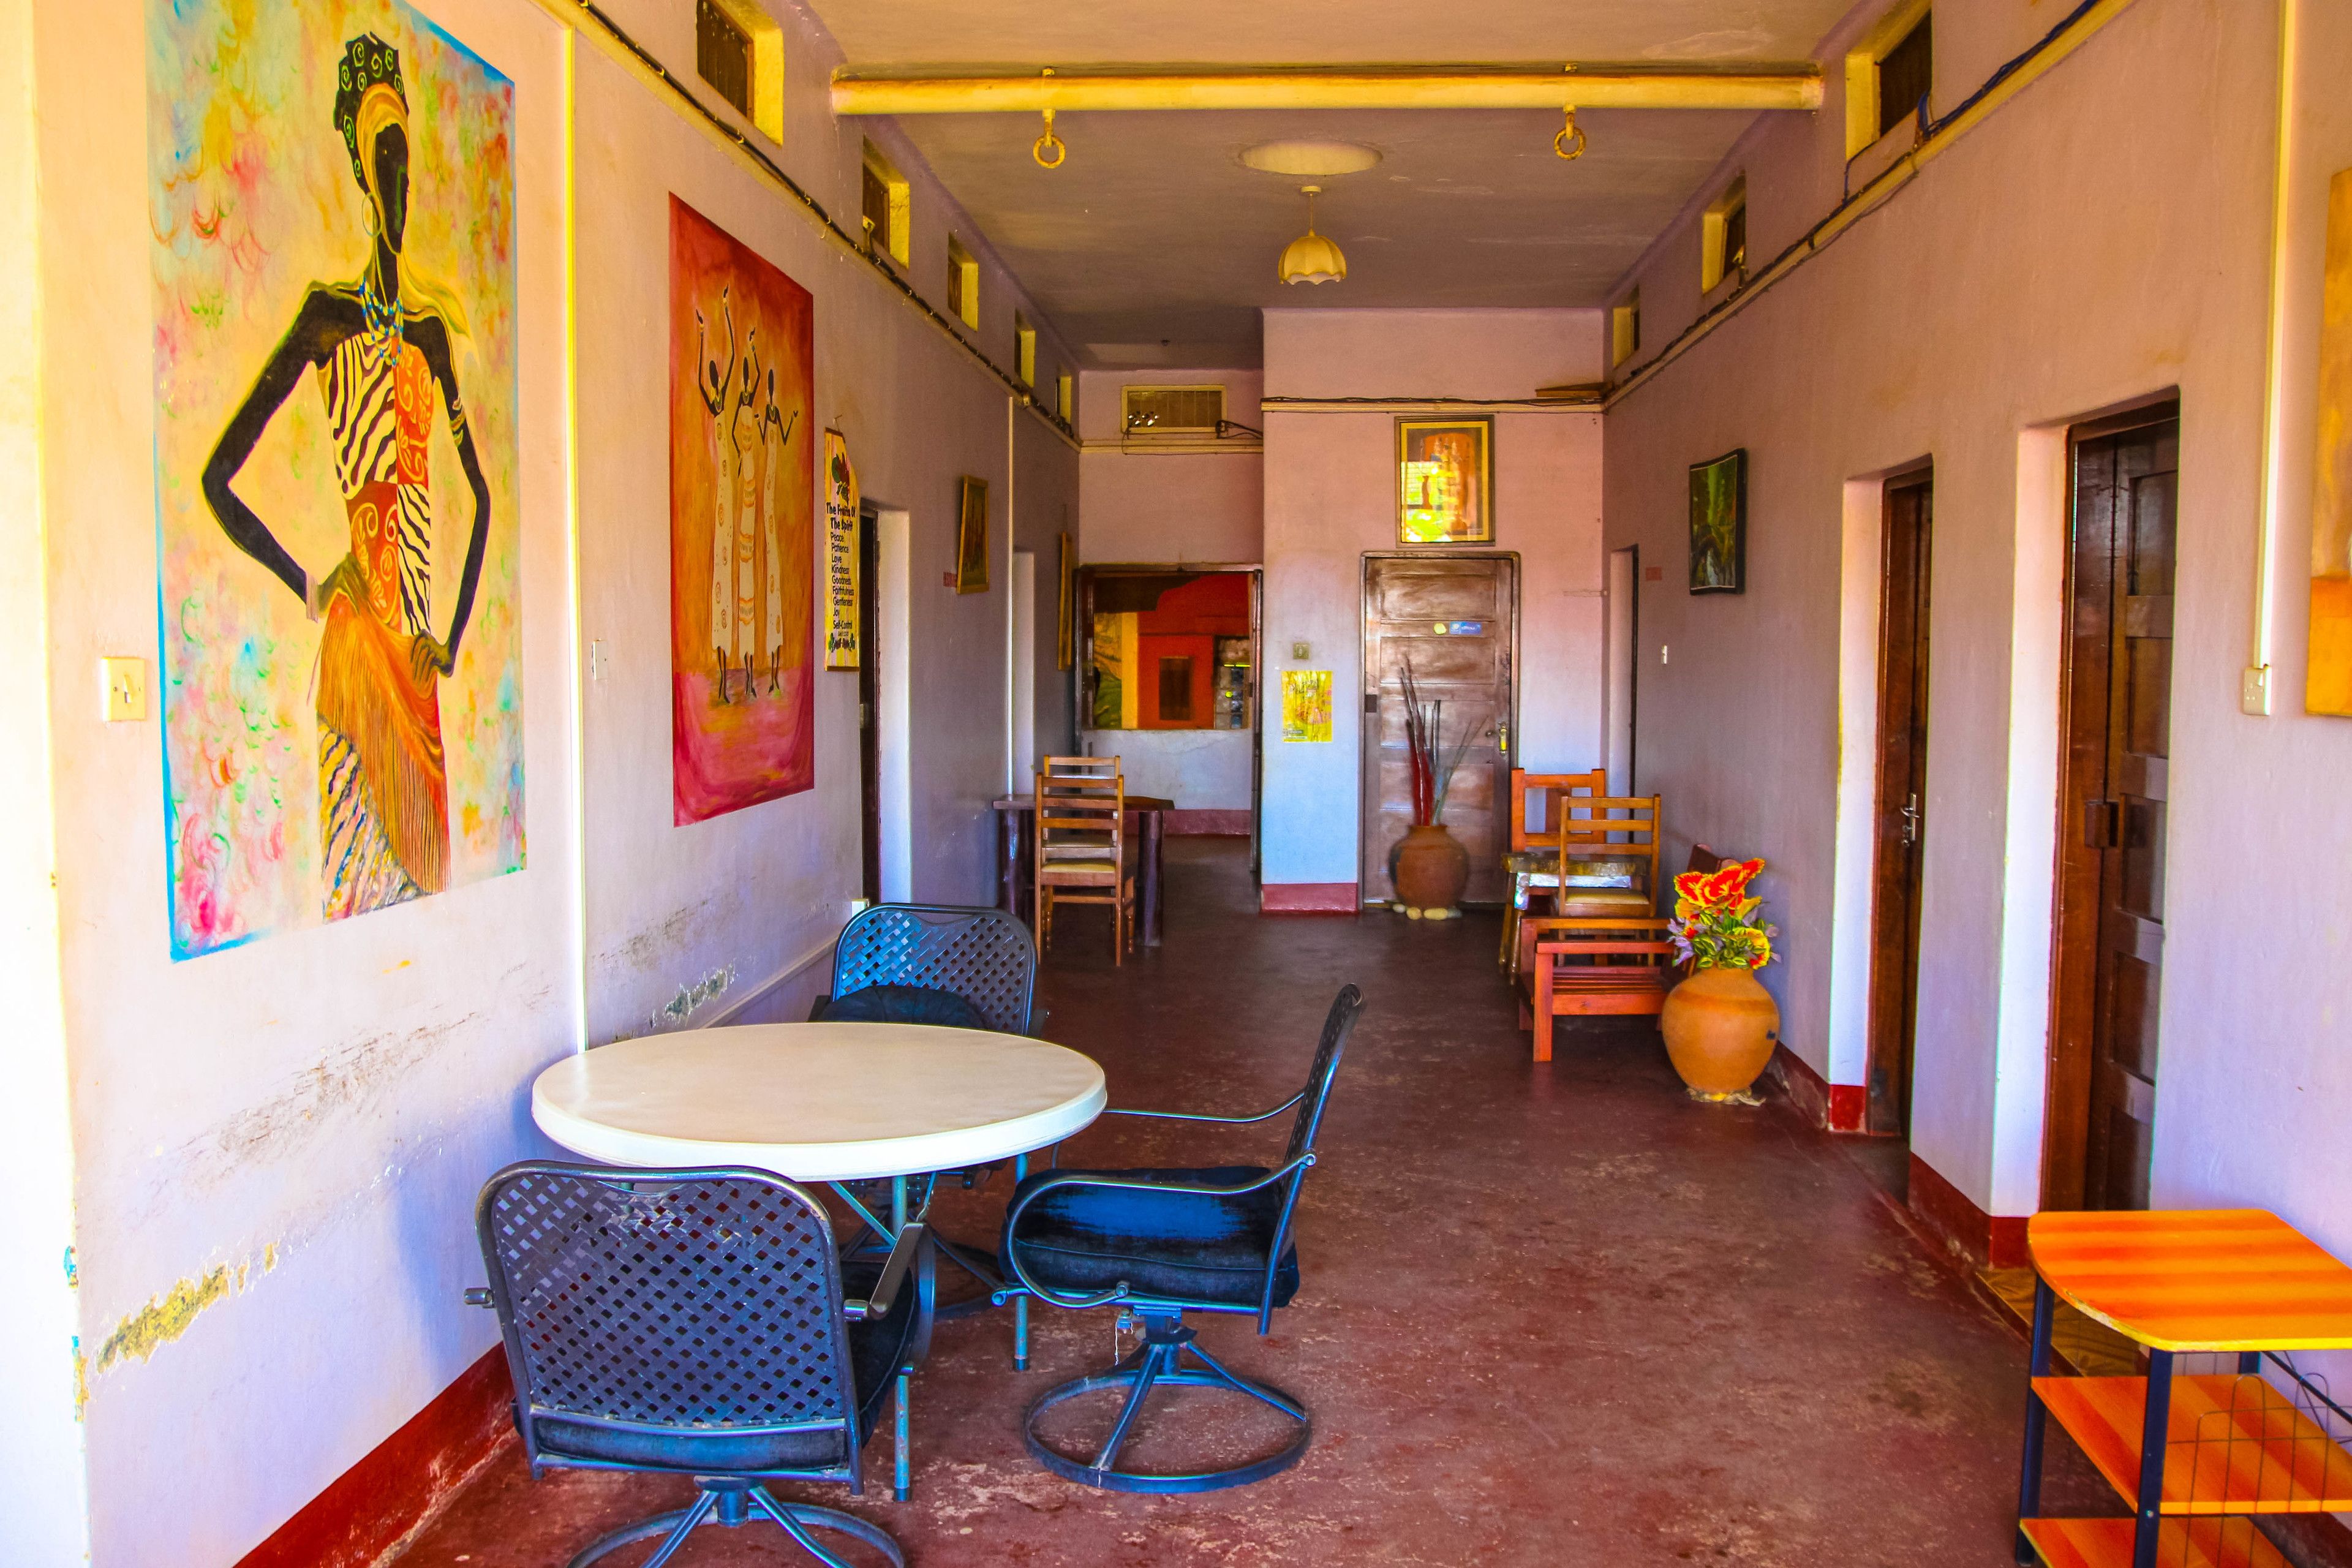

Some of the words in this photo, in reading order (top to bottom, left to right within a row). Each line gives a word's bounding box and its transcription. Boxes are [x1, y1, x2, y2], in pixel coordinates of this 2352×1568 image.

[826, 502, 836, 514] The
[837, 503, 850, 516] Fruits
[830, 517, 840, 530] The
[841, 519, 853, 533] Spirit
[831, 532, 844, 542] Peace
[831, 543, 849, 554] Patience
[831, 553, 842, 563] Love
[831, 564, 849, 575] Kindness
[832, 575, 851, 586] Goodness
[832, 586, 854, 596] Faithfulness
[832, 597, 853, 606] Gentleness
[833, 620, 853, 630] Self-Control
